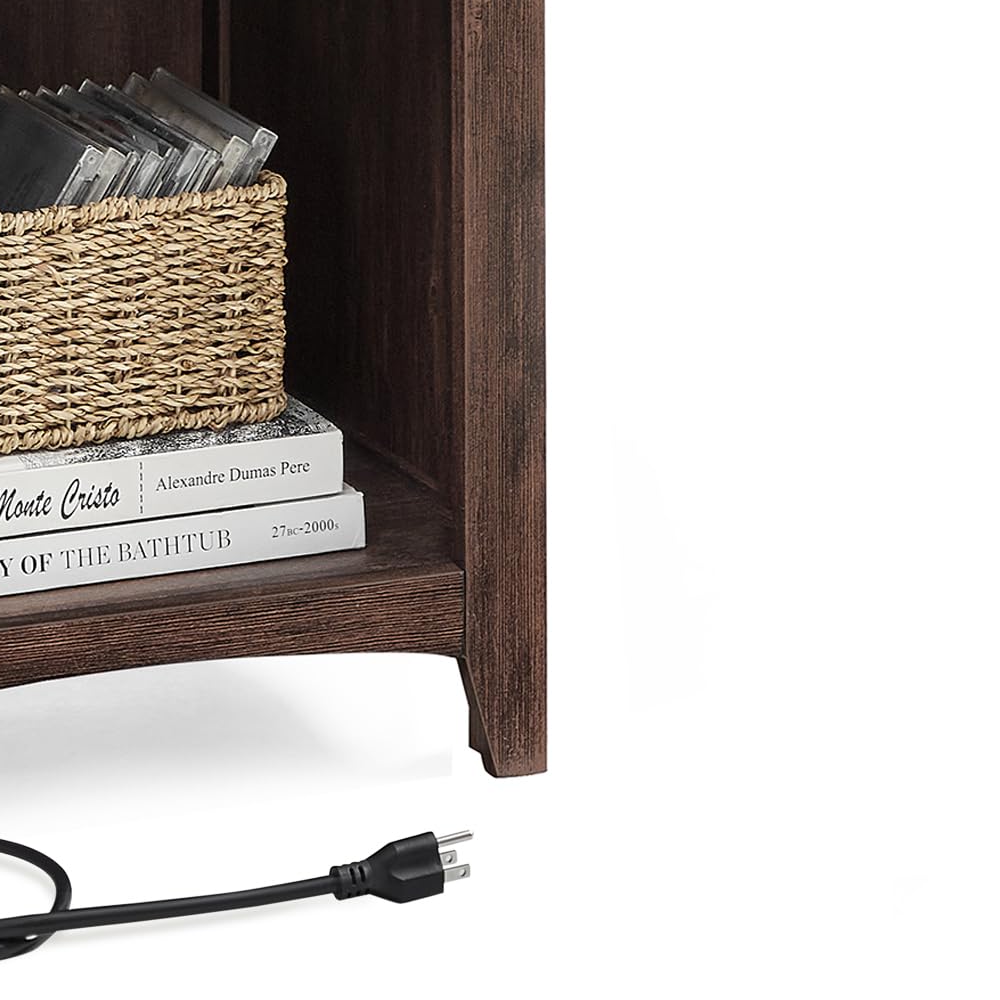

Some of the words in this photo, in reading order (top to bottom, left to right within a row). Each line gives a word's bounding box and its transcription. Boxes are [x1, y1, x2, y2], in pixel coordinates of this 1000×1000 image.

[155, 471, 226, 492] Alexandre
[229, 466, 277, 482] Dumas
[280, 460, 311, 476] Pere
[60, 478, 121, 521] Cristo
[20, 552, 54, 575] OF
[60, 545, 112, 570] THE
[117, 529, 232, 562] BATHTUB
